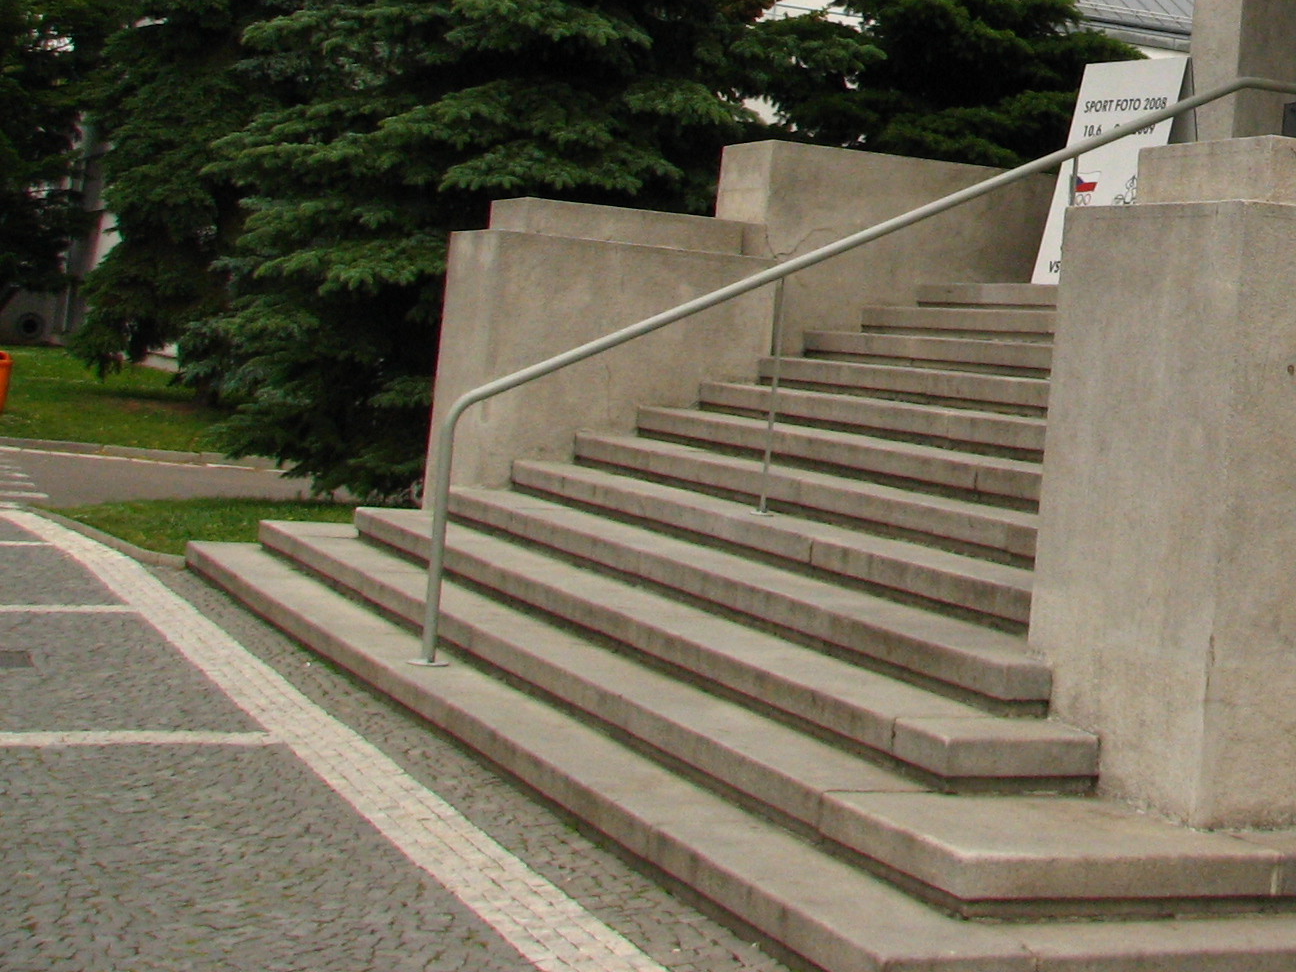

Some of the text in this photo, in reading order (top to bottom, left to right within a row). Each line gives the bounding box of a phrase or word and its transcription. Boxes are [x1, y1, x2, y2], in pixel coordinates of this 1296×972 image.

[1083, 97, 1168, 113] SPORT FOTO 2008
